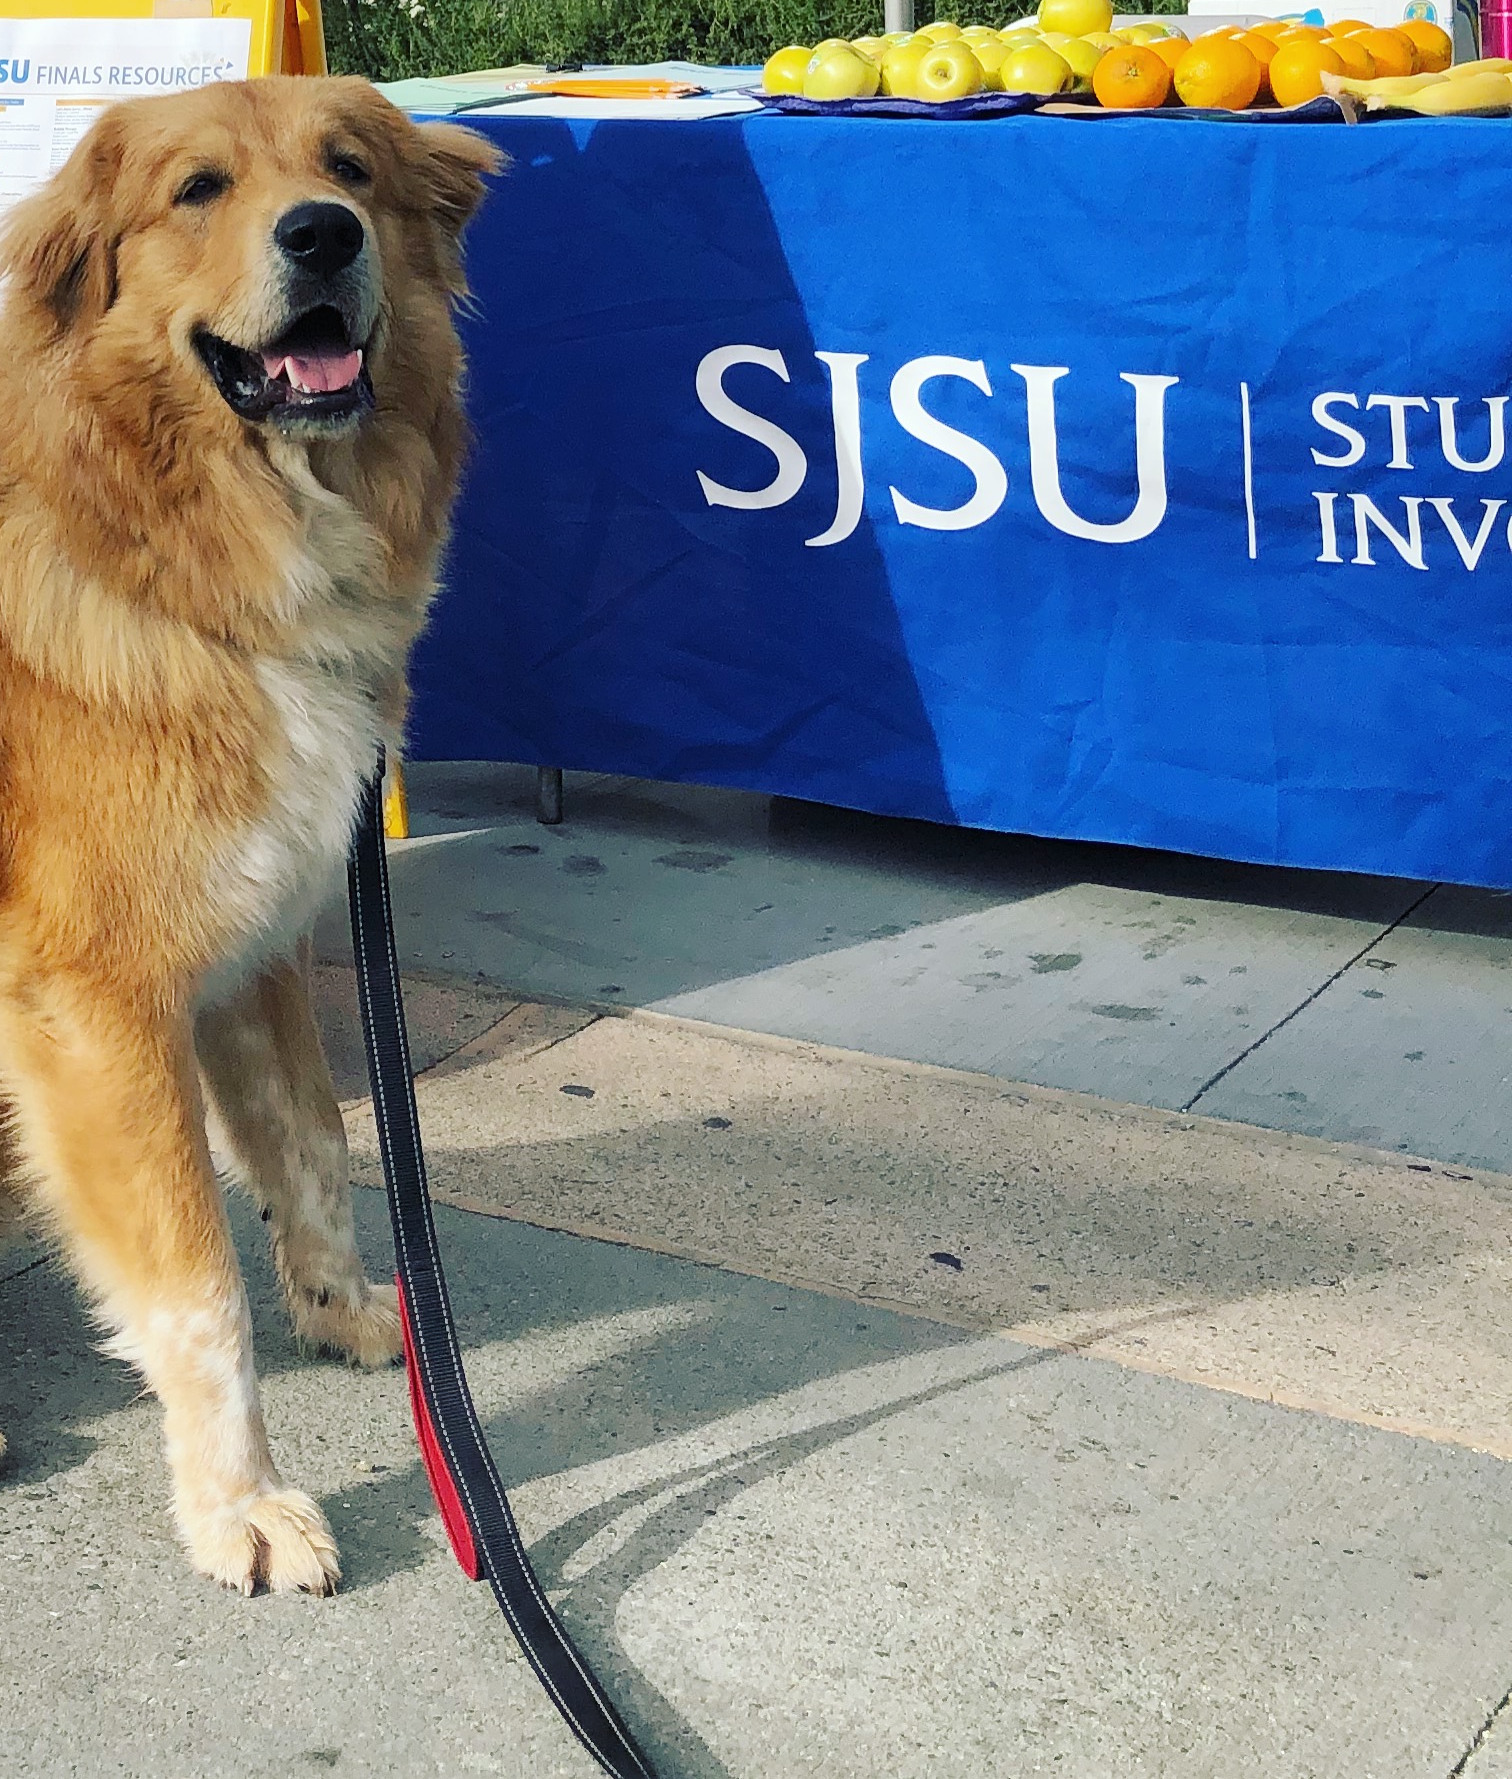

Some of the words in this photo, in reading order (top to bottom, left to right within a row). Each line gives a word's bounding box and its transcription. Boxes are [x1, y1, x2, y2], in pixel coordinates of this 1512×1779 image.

[36, 65, 102, 85] FINALS
[108, 65, 223, 86] RESOURCES
[694, 344, 1180, 548] SJSU
[1309, 391, 1510, 473] STU
[1310, 490, 1512, 572] INV
